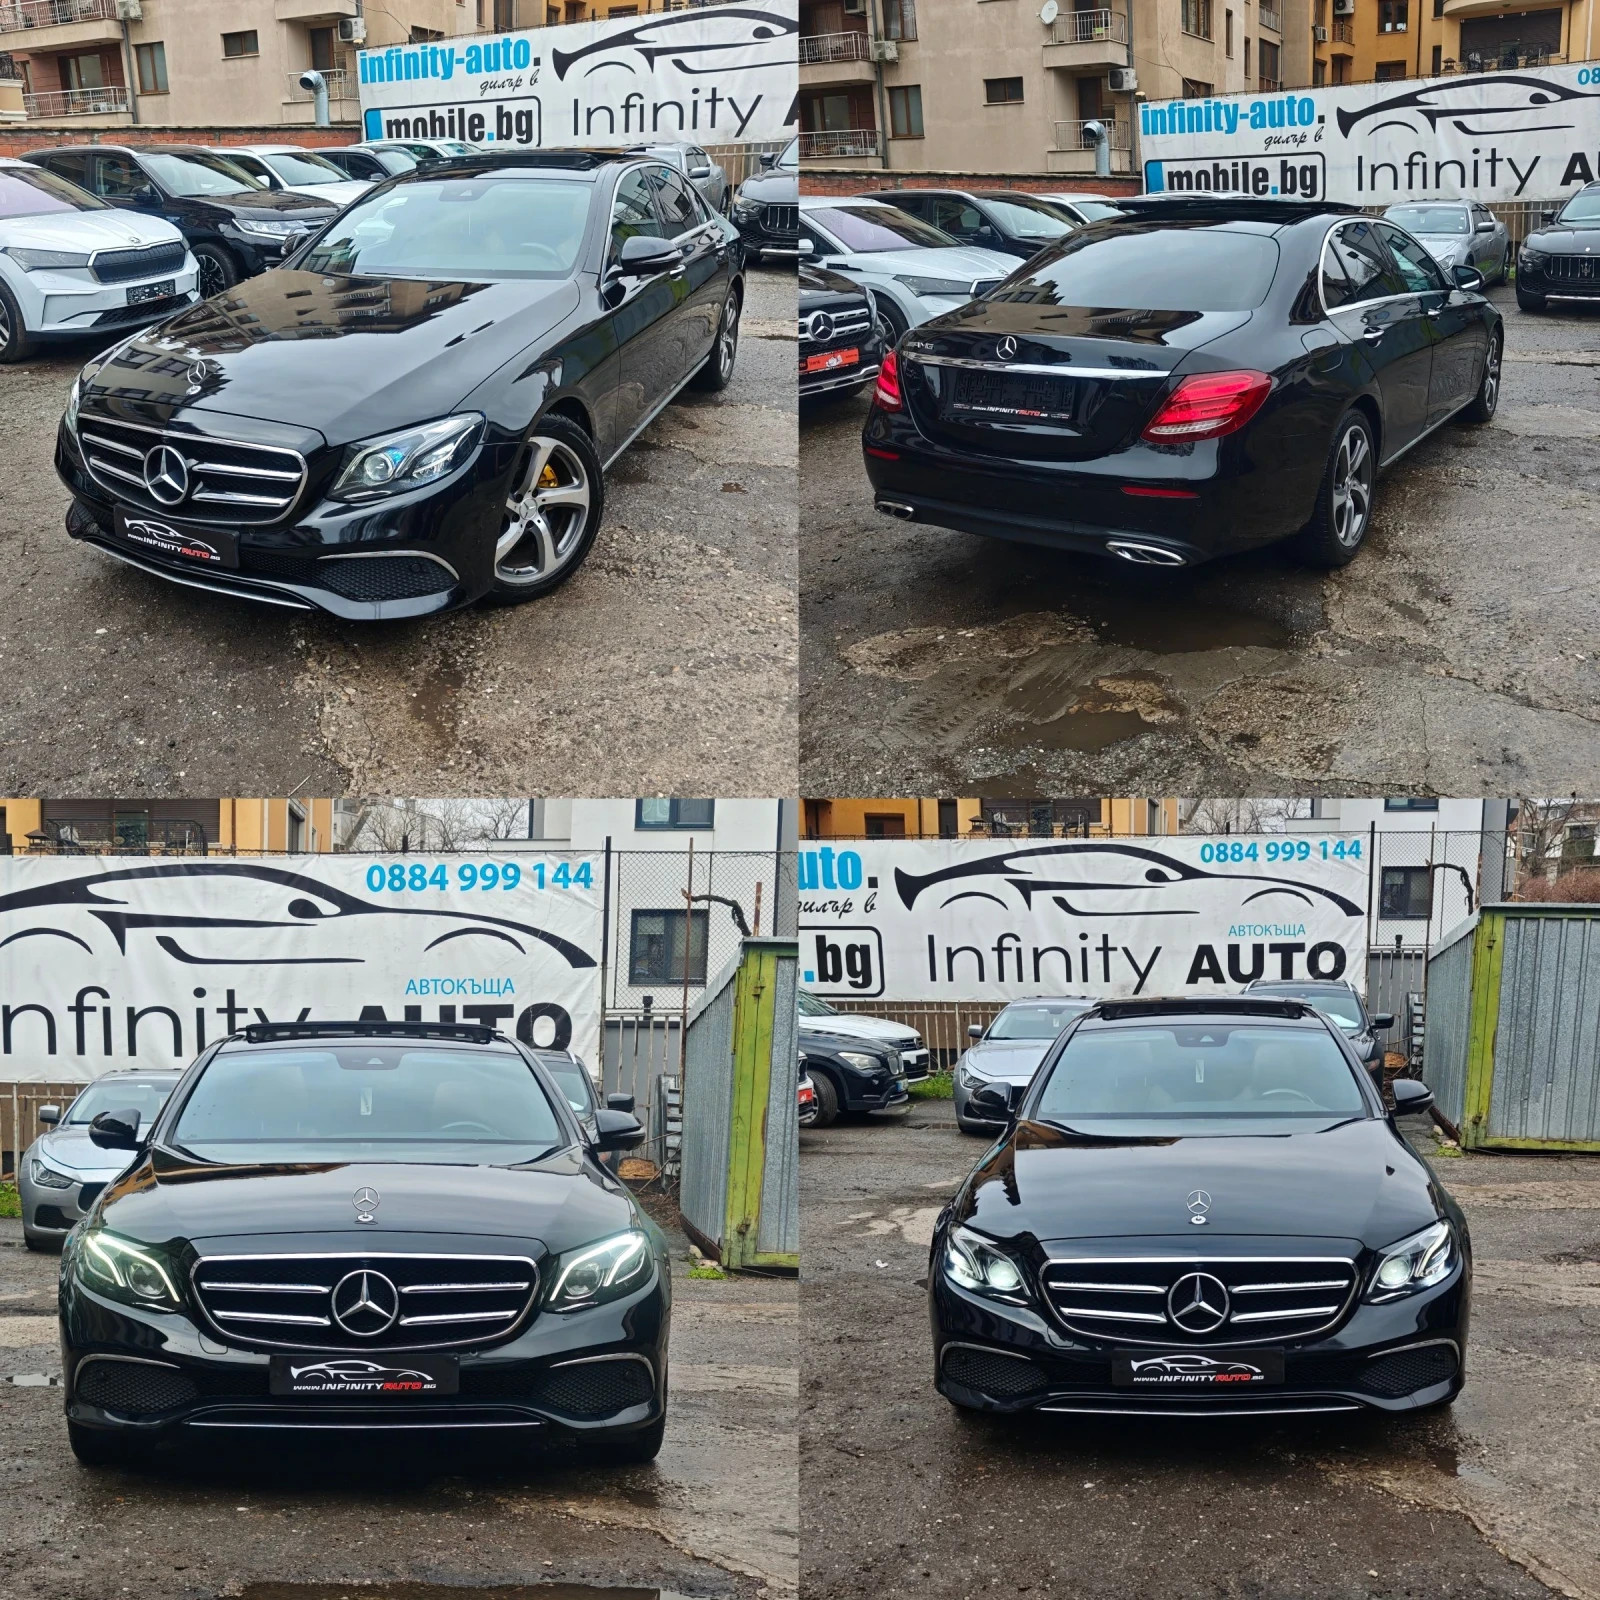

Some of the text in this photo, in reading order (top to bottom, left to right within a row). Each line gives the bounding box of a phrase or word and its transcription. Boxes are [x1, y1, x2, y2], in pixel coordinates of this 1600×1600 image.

[573, 87, 764, 138] Infinity
[1357, 148, 1541, 196] Infinity
[1200, 839, 1362, 864] 0884 999 144
[366, 861, 594, 893] 0884 999 144
[1228, 923, 1306, 938] АВТОКЪЩА
[927, 932, 1347, 995] Infinity AUTO
[405, 978, 515, 998] АВТОКЪЩА
